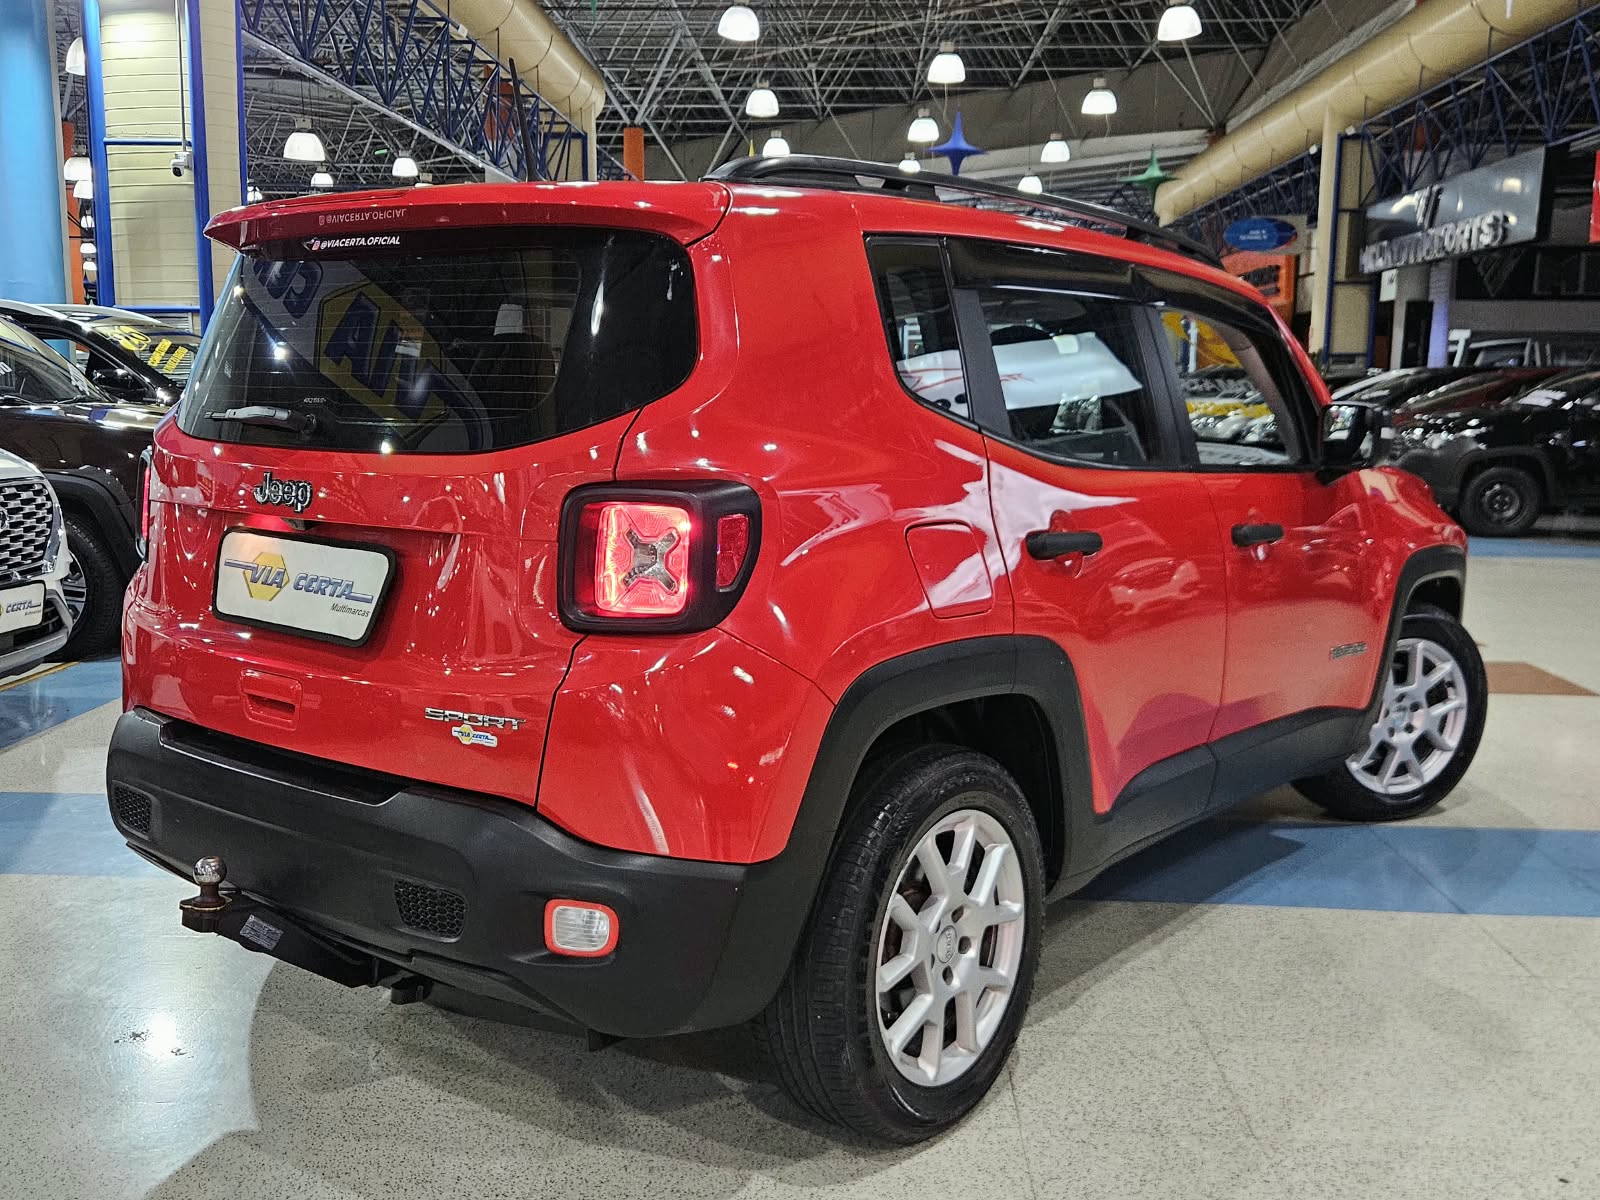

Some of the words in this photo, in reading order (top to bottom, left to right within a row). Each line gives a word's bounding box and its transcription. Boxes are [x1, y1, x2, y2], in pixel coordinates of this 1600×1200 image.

[320, 236, 401, 250] @VIACERTA.OFICIAL
[253, 471, 313, 514] Jeep
[244, 563, 287, 589] VIA
[293, 572, 357, 601] CERTA
[330, 602, 370, 617] Multimarcas
[424, 707, 527, 730] SPORT
